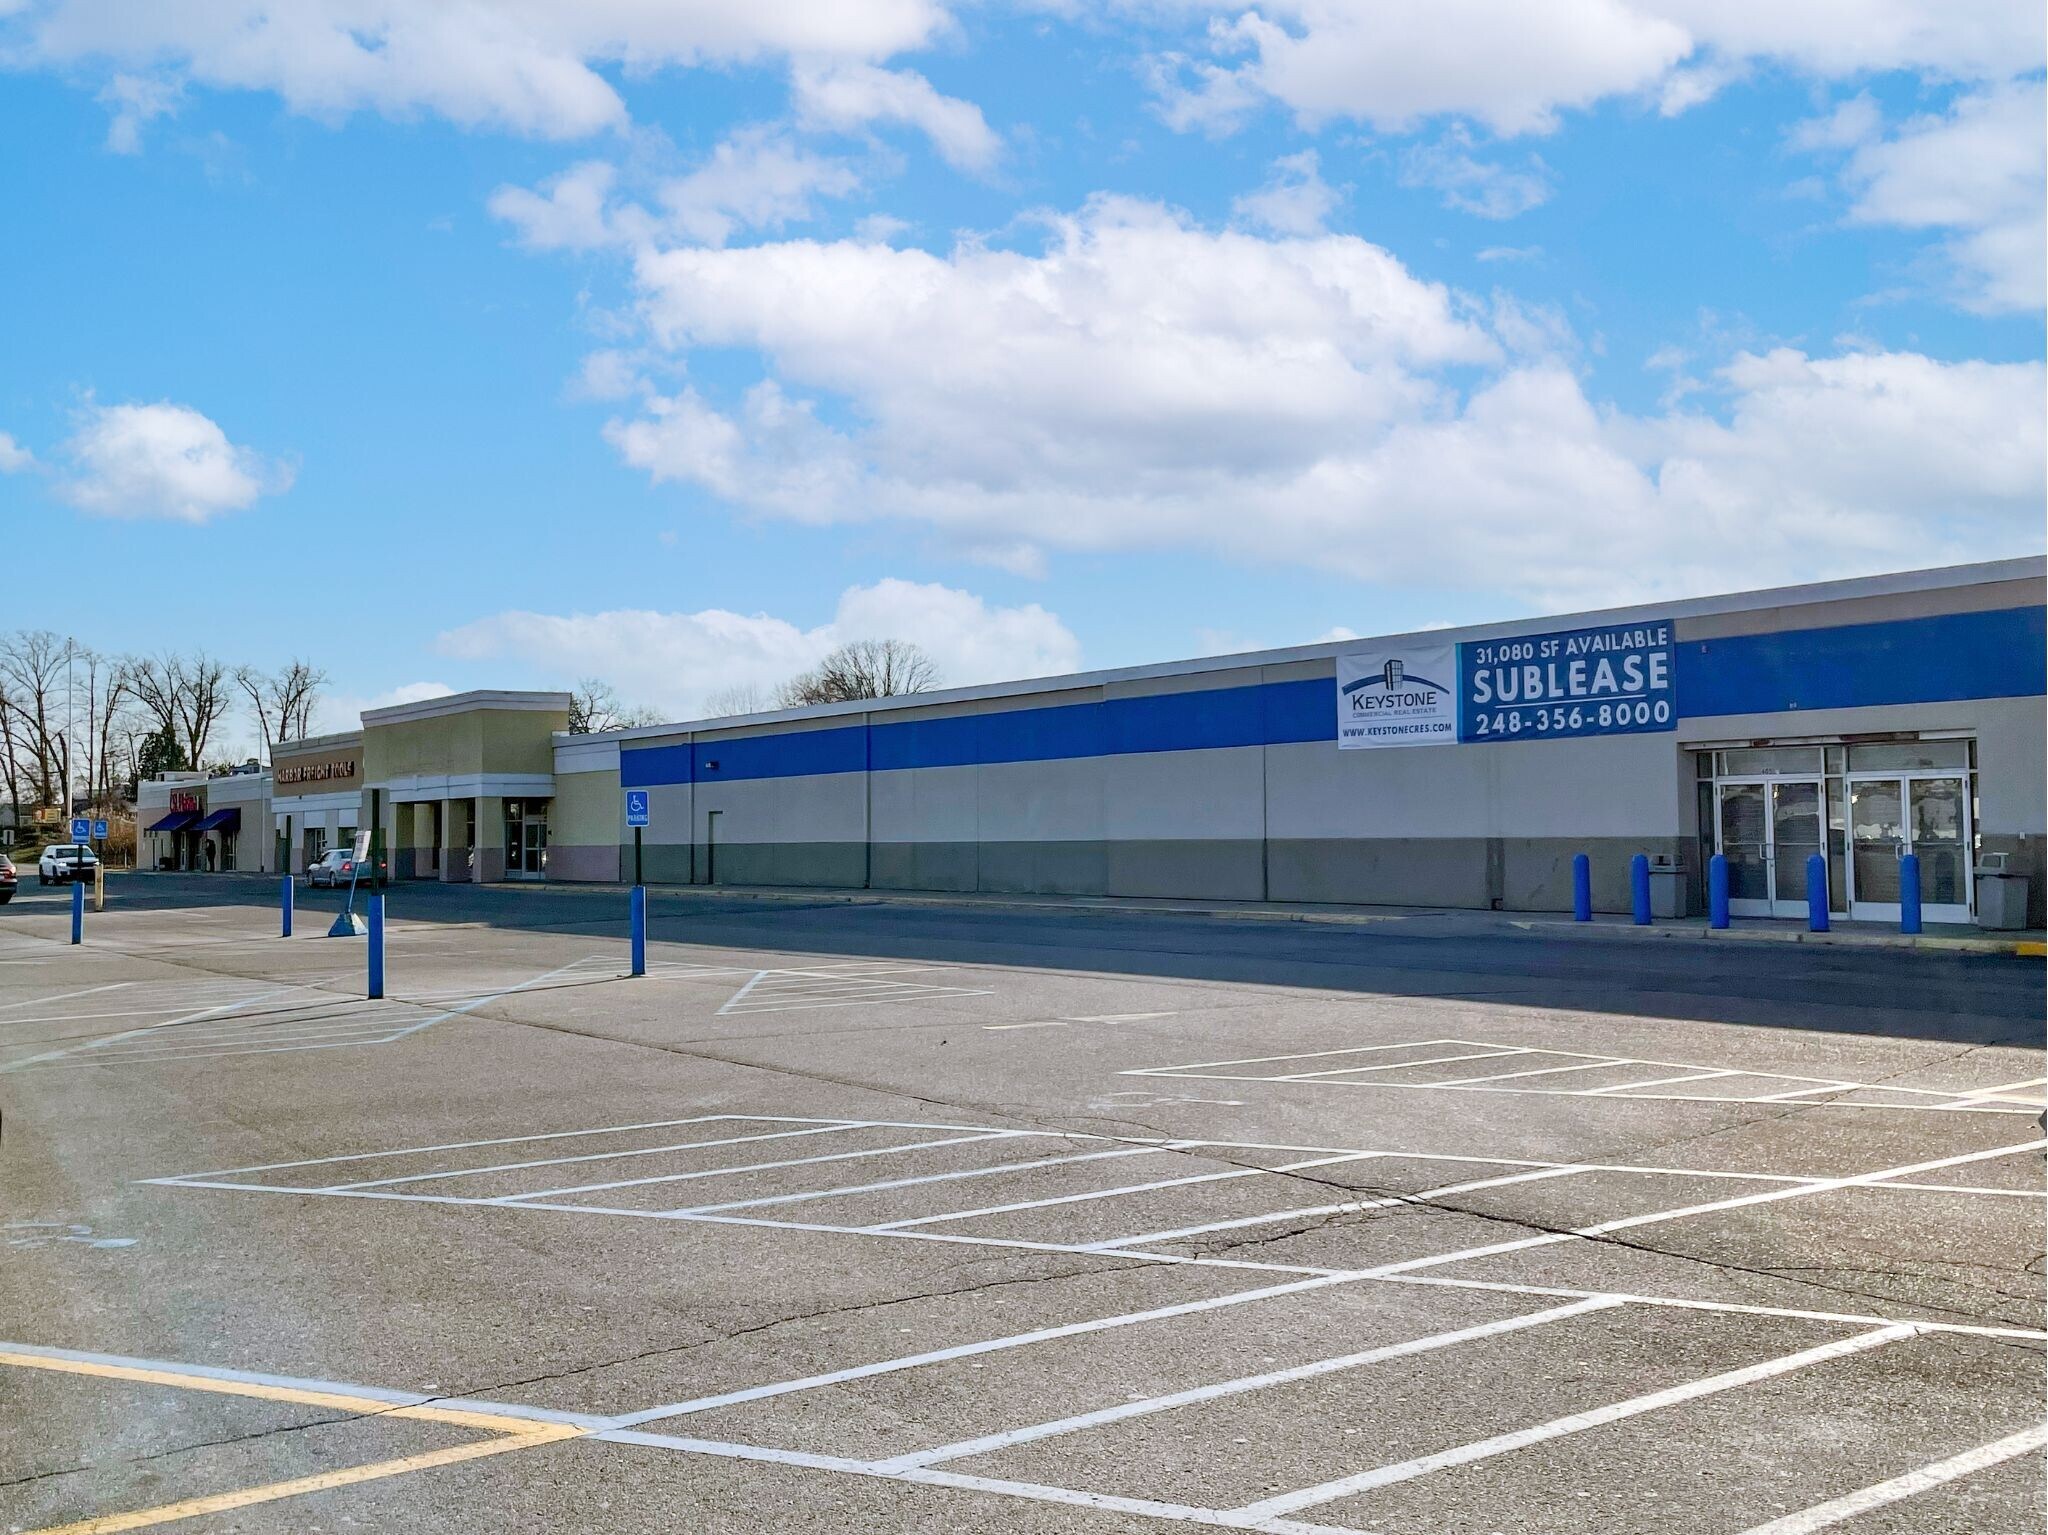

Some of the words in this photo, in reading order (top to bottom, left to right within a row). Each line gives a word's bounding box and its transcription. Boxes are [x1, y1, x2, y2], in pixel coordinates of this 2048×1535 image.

[1476, 644, 1534, 665] 31,080
[1540, 640, 1559, 658] SF
[1565, 627, 1668, 656] AVAILABLE
[1473, 652, 1669, 703] SUBLEASE
[1352, 691, 1437, 710] KEYSTONE
[1475, 700, 1670, 735] 248-356-8000
[1343, 723, 1452, 737] WWW.KEYSTONECRES.COM
